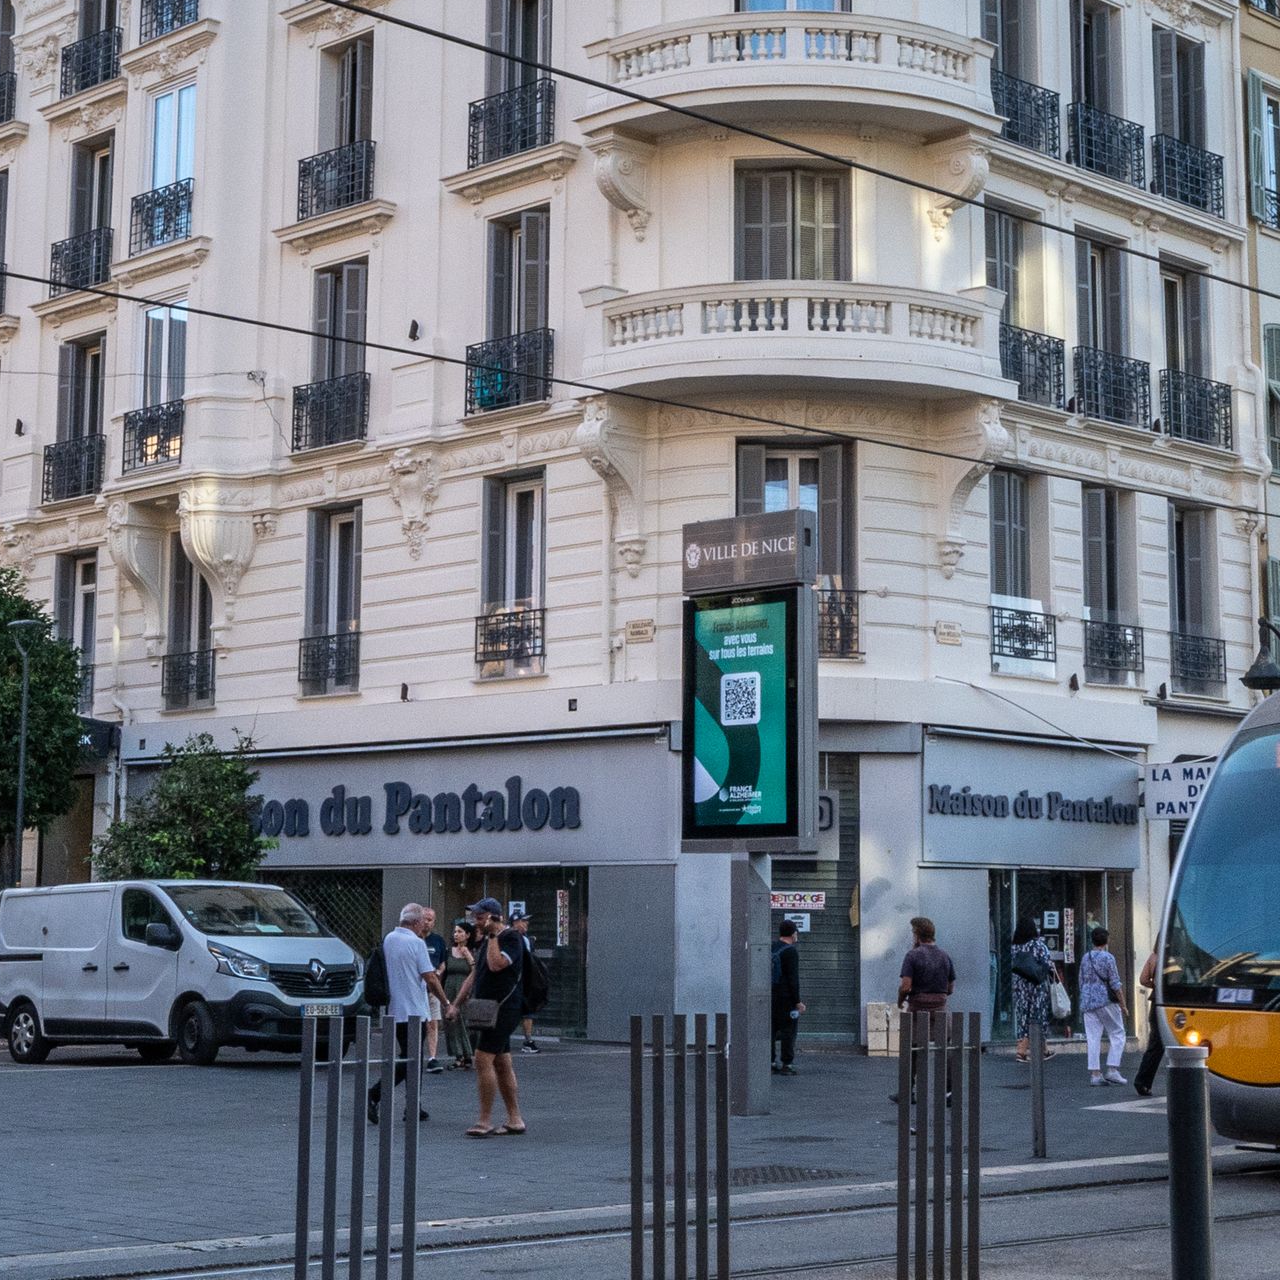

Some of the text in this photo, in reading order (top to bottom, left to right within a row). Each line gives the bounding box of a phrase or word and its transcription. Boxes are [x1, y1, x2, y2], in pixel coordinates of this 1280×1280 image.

[703, 536, 796, 561] VILLE DE NICE
[723, 632, 757, 646] avec vous
[708, 643, 774, 660] sur tous les terrains
[1152, 768, 1172, 781] LA
[320, 784, 373, 838] du
[384, 775, 583, 836] Pantalon
[928, 783, 1139, 826] Maison du Pantalon
